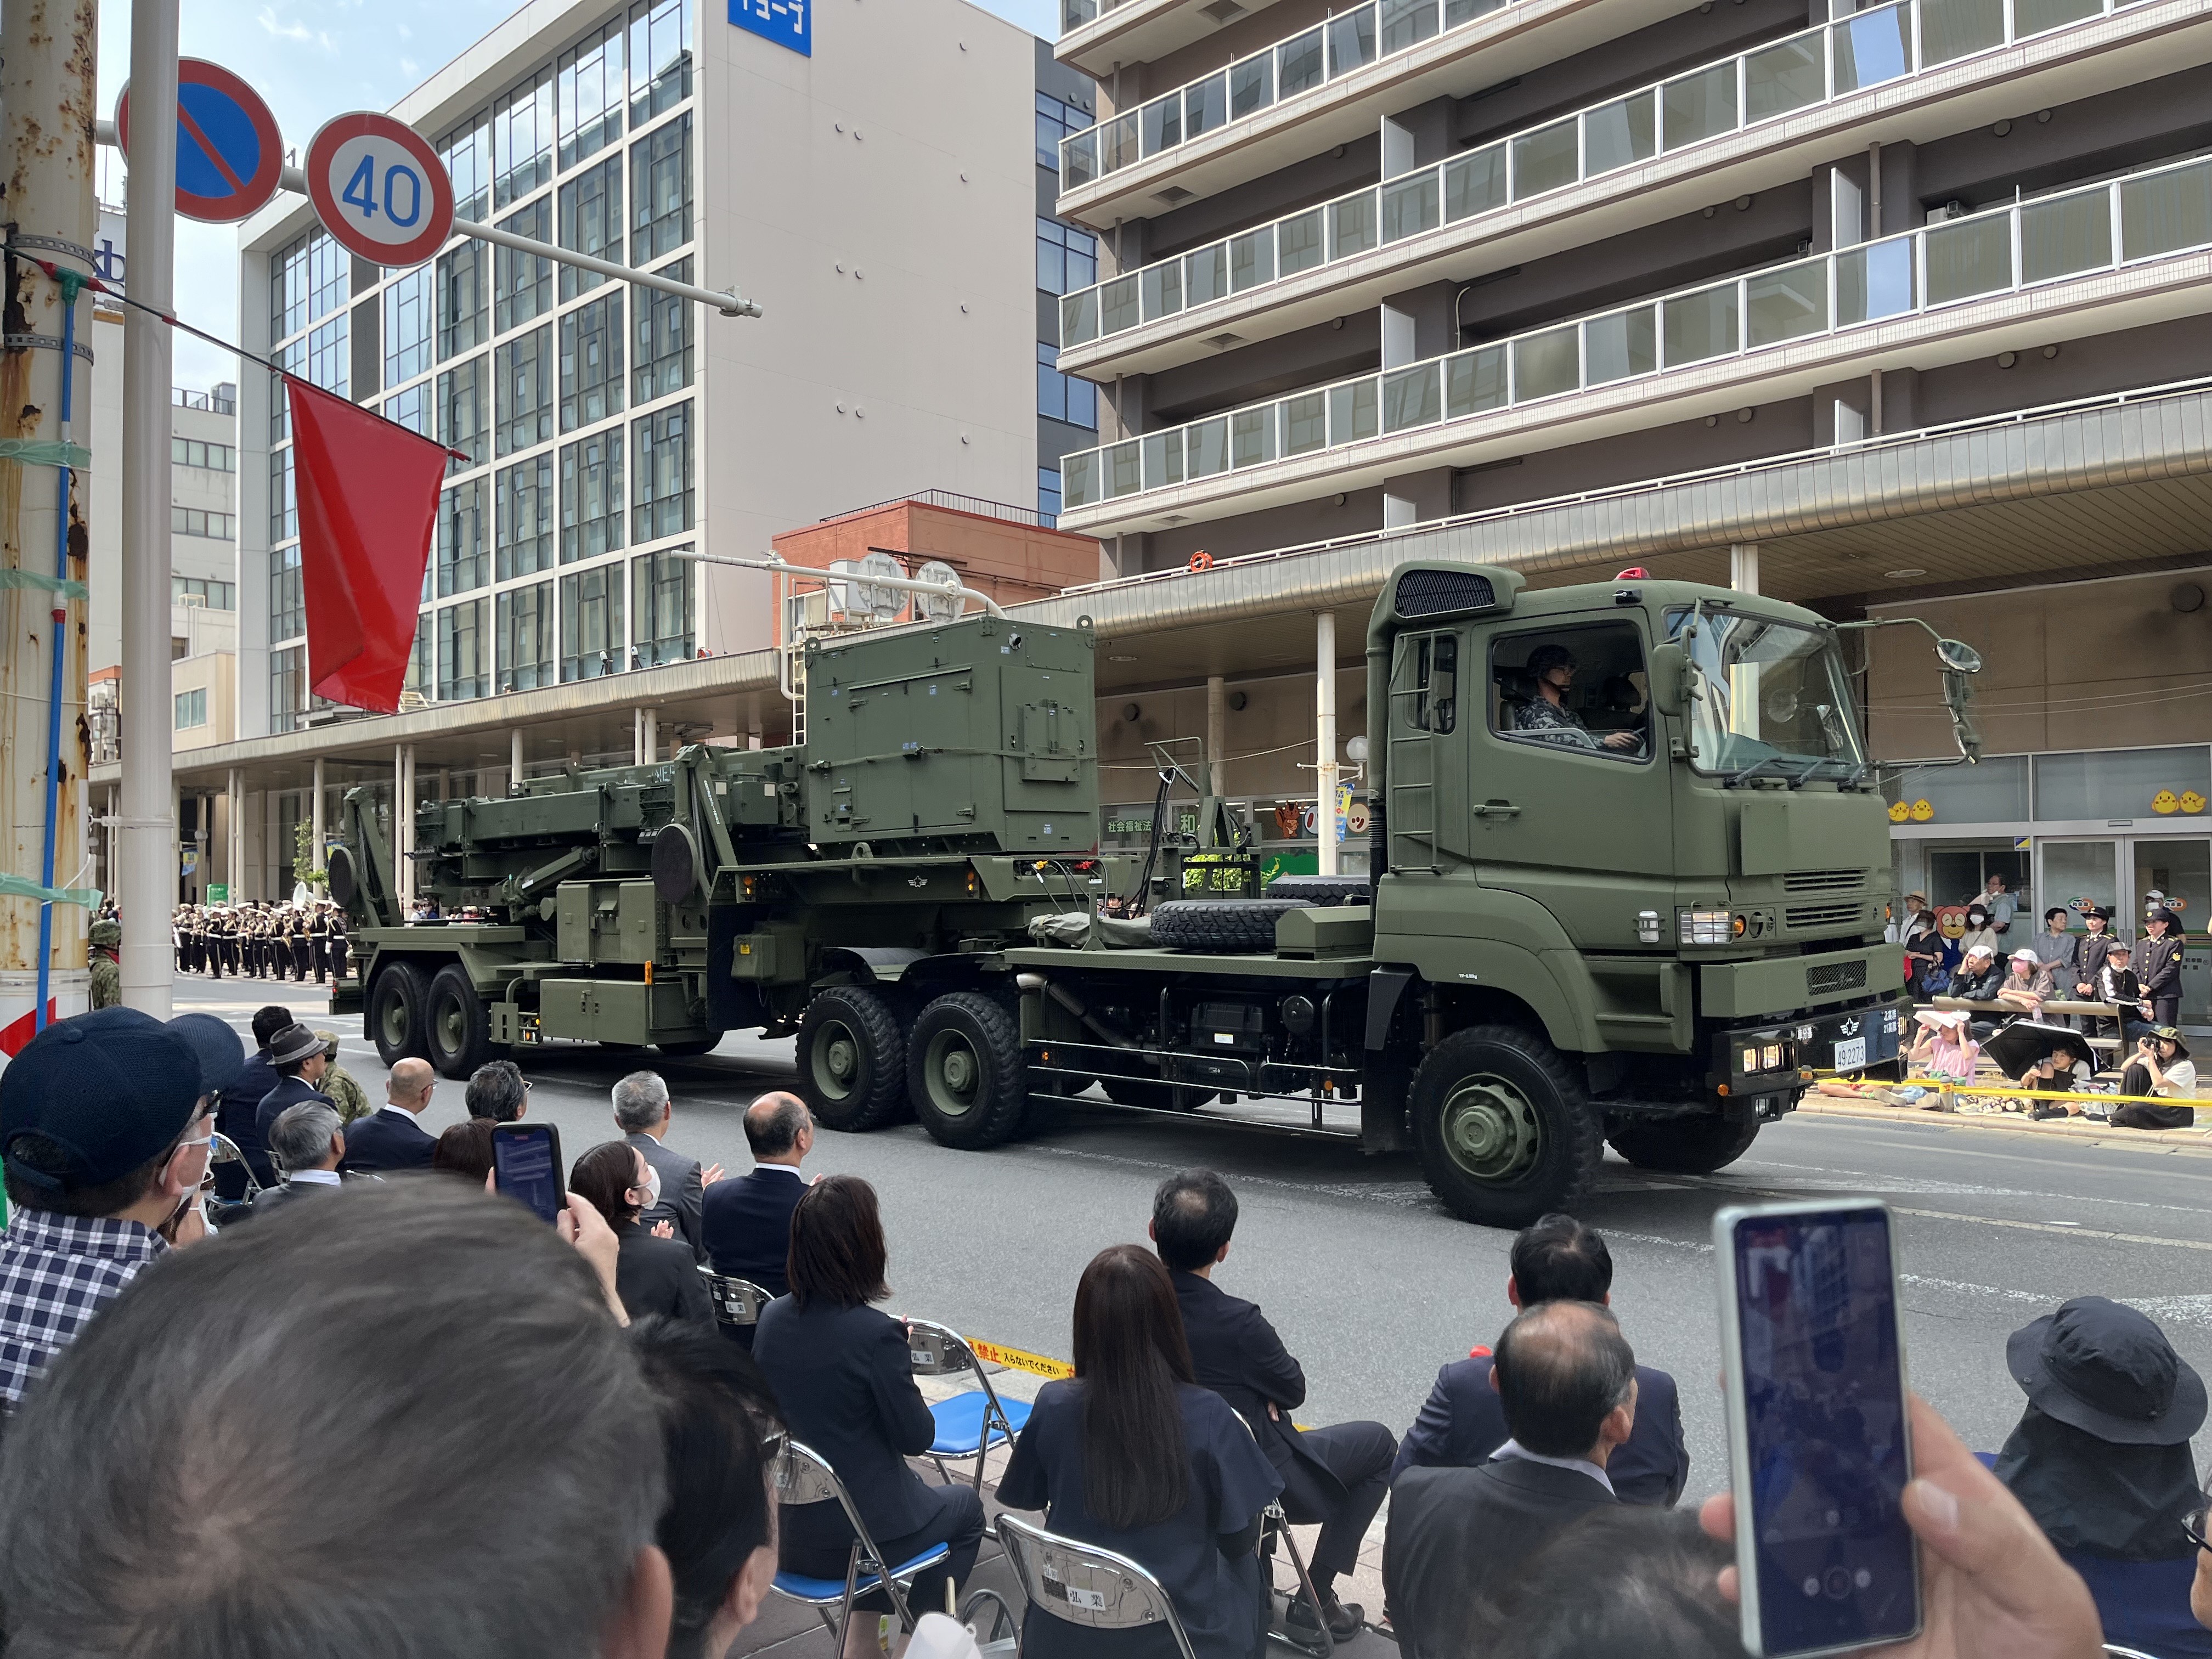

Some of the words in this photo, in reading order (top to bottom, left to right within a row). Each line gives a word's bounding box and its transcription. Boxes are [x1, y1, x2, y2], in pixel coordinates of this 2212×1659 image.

[342, 155, 420, 227] 40
[1108, 820, 1152, 833] 社会福祉法
[1180, 814, 1195, 833] 和
[1003, 1352, 1060, 1375] 入らないでください
